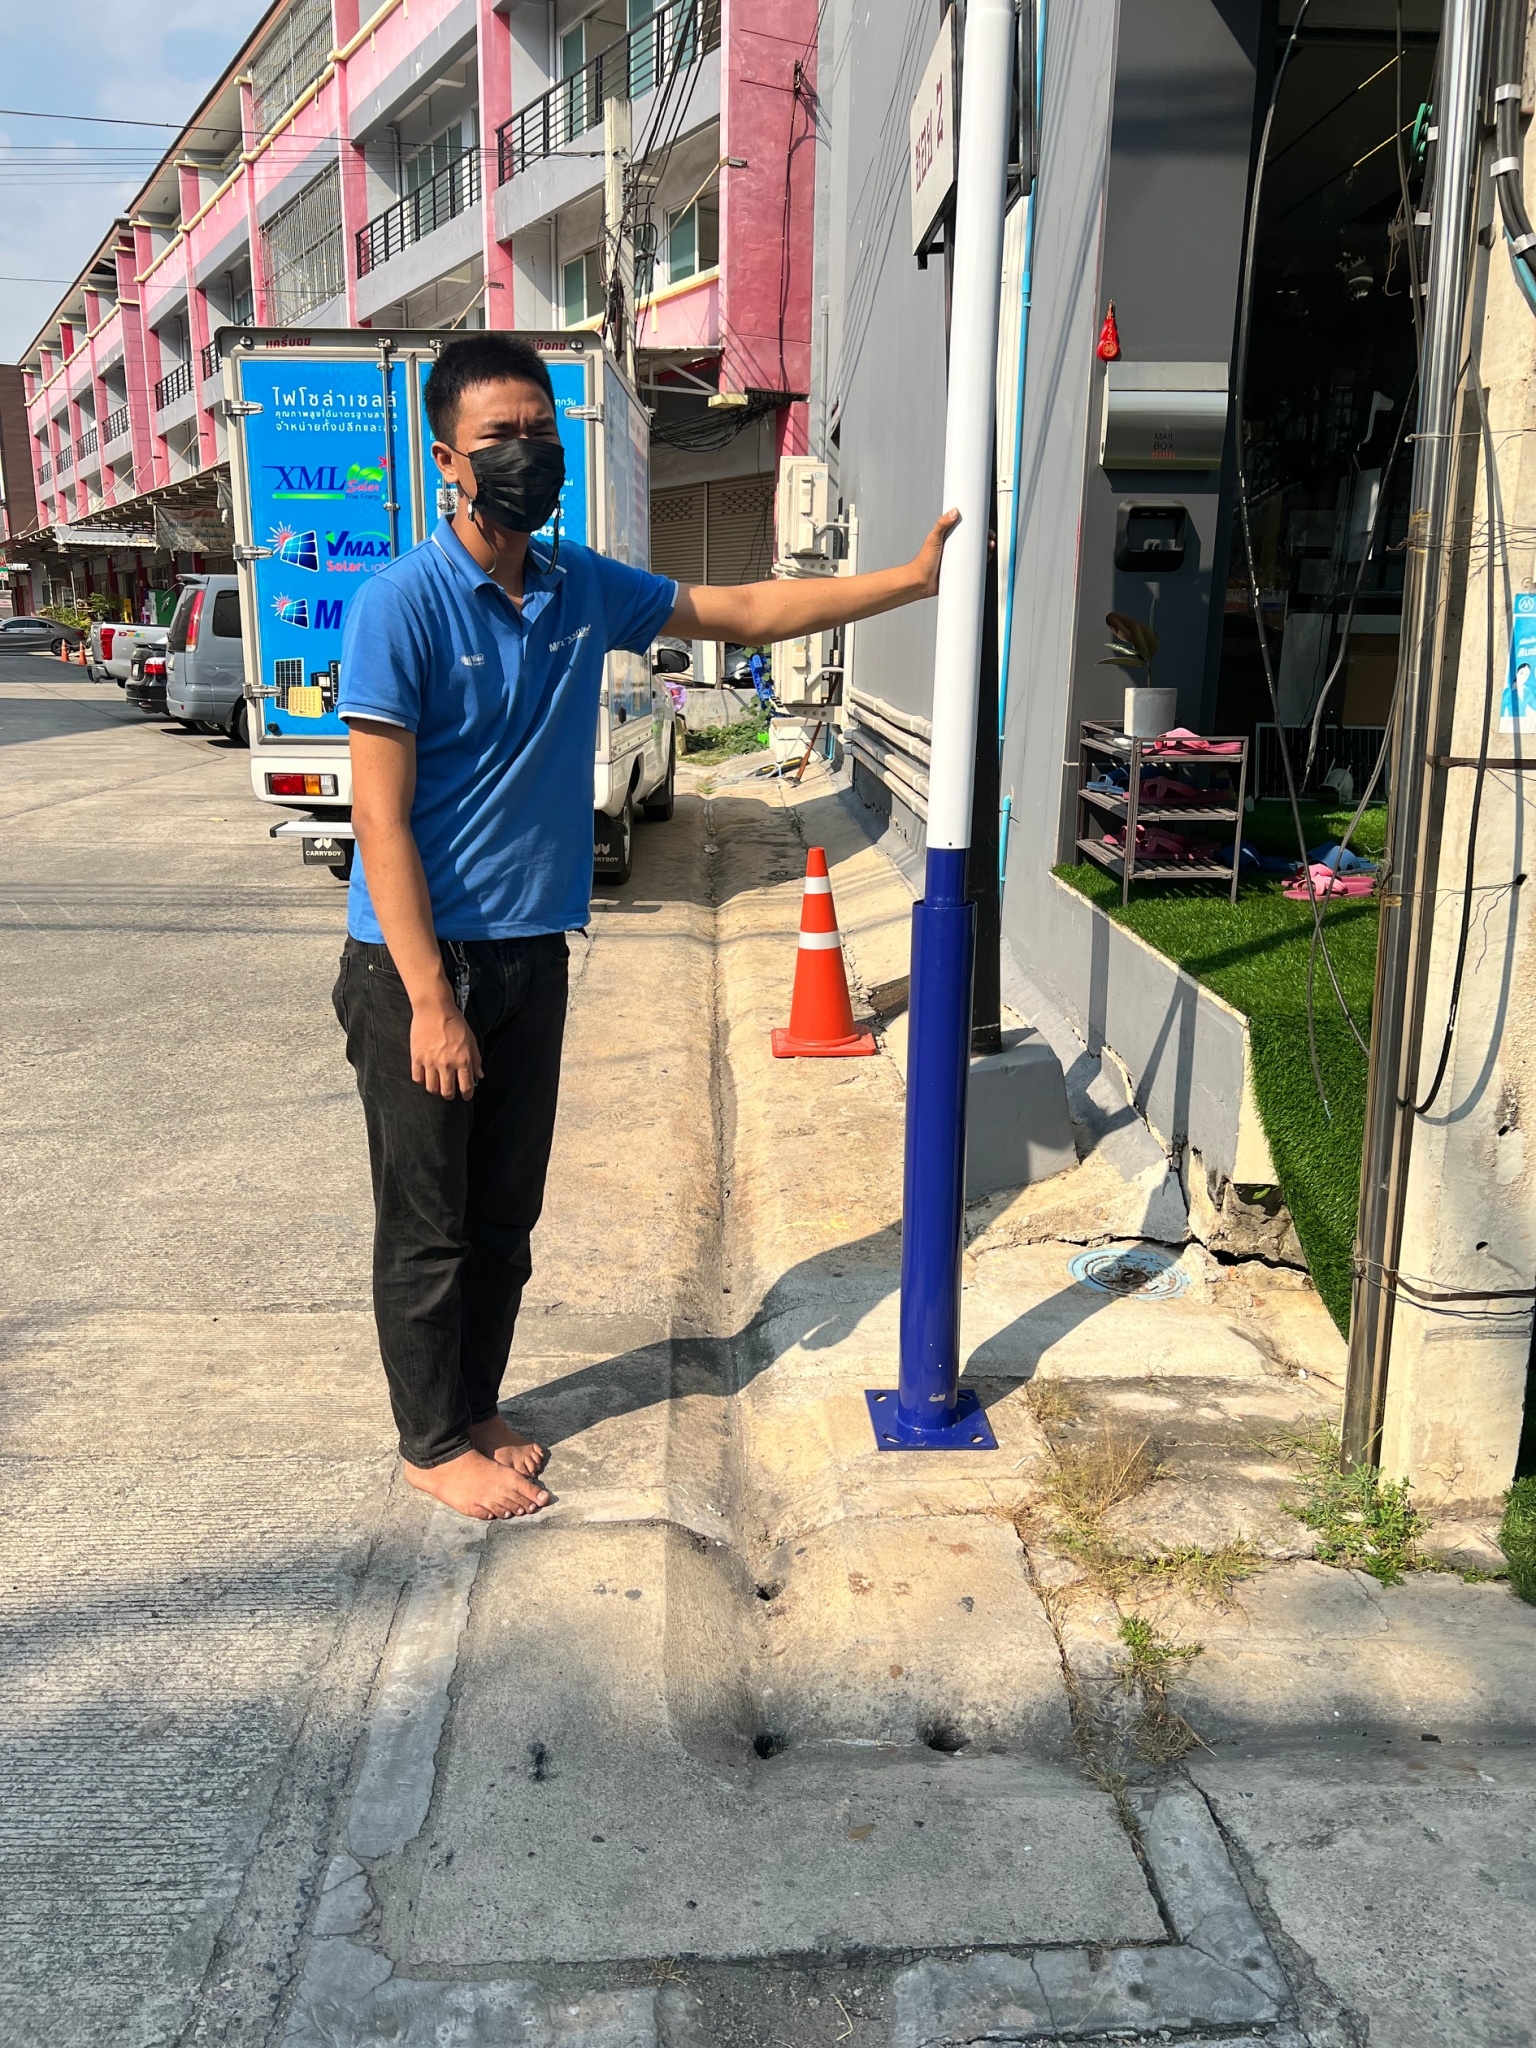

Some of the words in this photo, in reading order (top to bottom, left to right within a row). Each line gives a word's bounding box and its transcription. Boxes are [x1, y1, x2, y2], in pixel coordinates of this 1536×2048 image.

[936, 72, 944, 149] 2
[275, 409, 397, 420] คุณภาพสูงได้มาตรฐานสาล
[275, 419, 398, 432] จำหน่ายทั้งปลีกและง
[1154, 432, 1175, 441] MAIL
[1153, 441, 1174, 450] BOX
[262, 465, 346, 491] XML
[346, 479, 380, 494] Solar
[360, 493, 381, 501] Energy
[325, 530, 391, 557] VMAX
